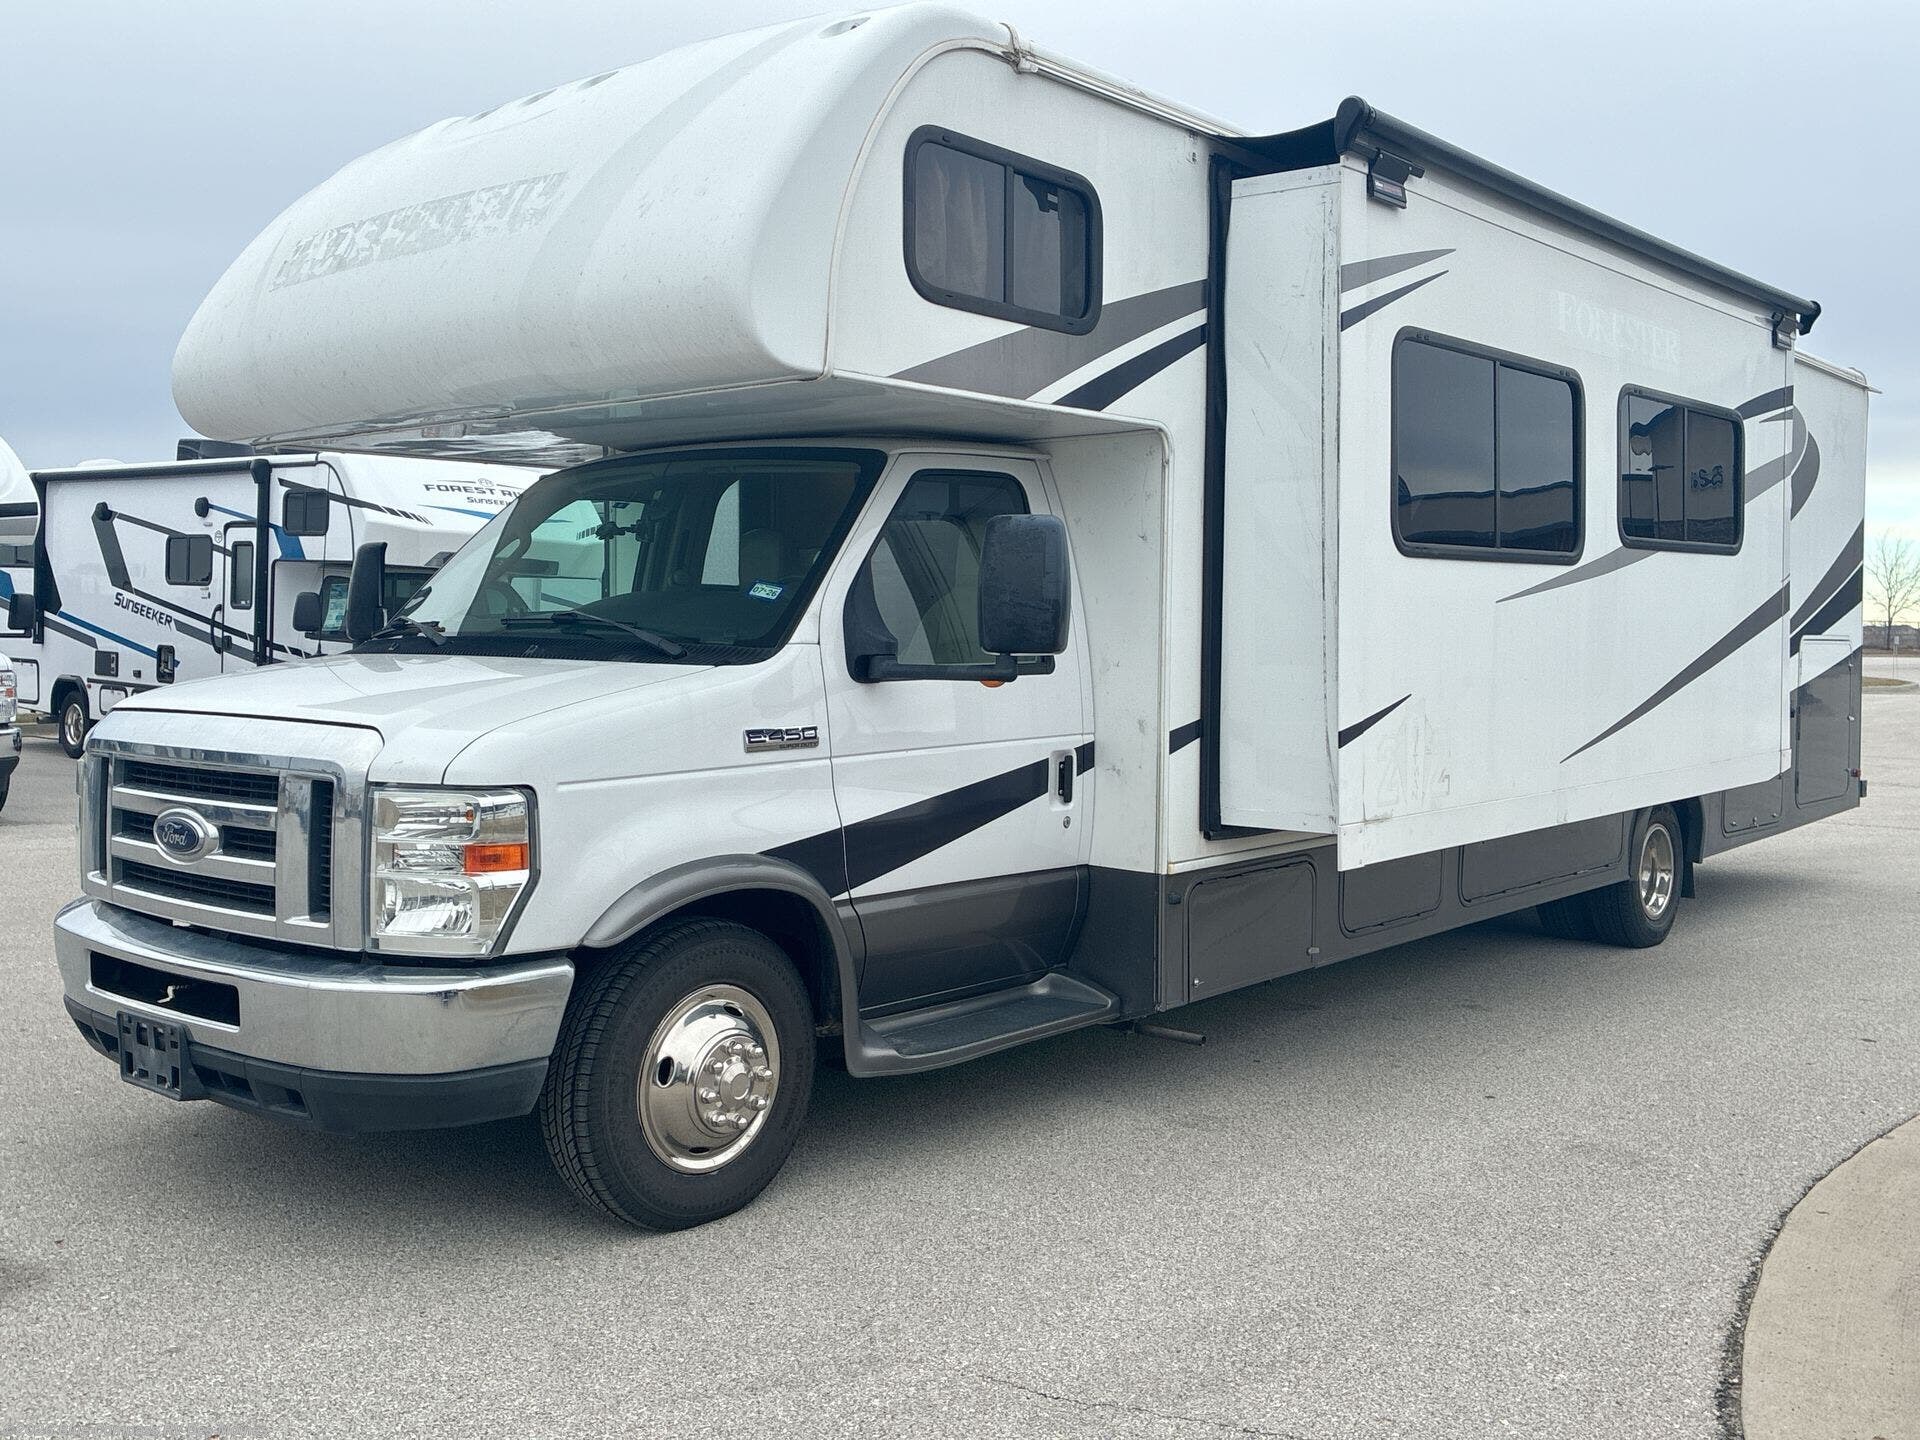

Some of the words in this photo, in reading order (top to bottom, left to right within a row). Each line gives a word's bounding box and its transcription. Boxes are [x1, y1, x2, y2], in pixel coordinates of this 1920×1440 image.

[423, 484, 496, 496] FOREST
[114, 592, 173, 631] SUNSEEKER
[162, 822, 188, 846] Ford
